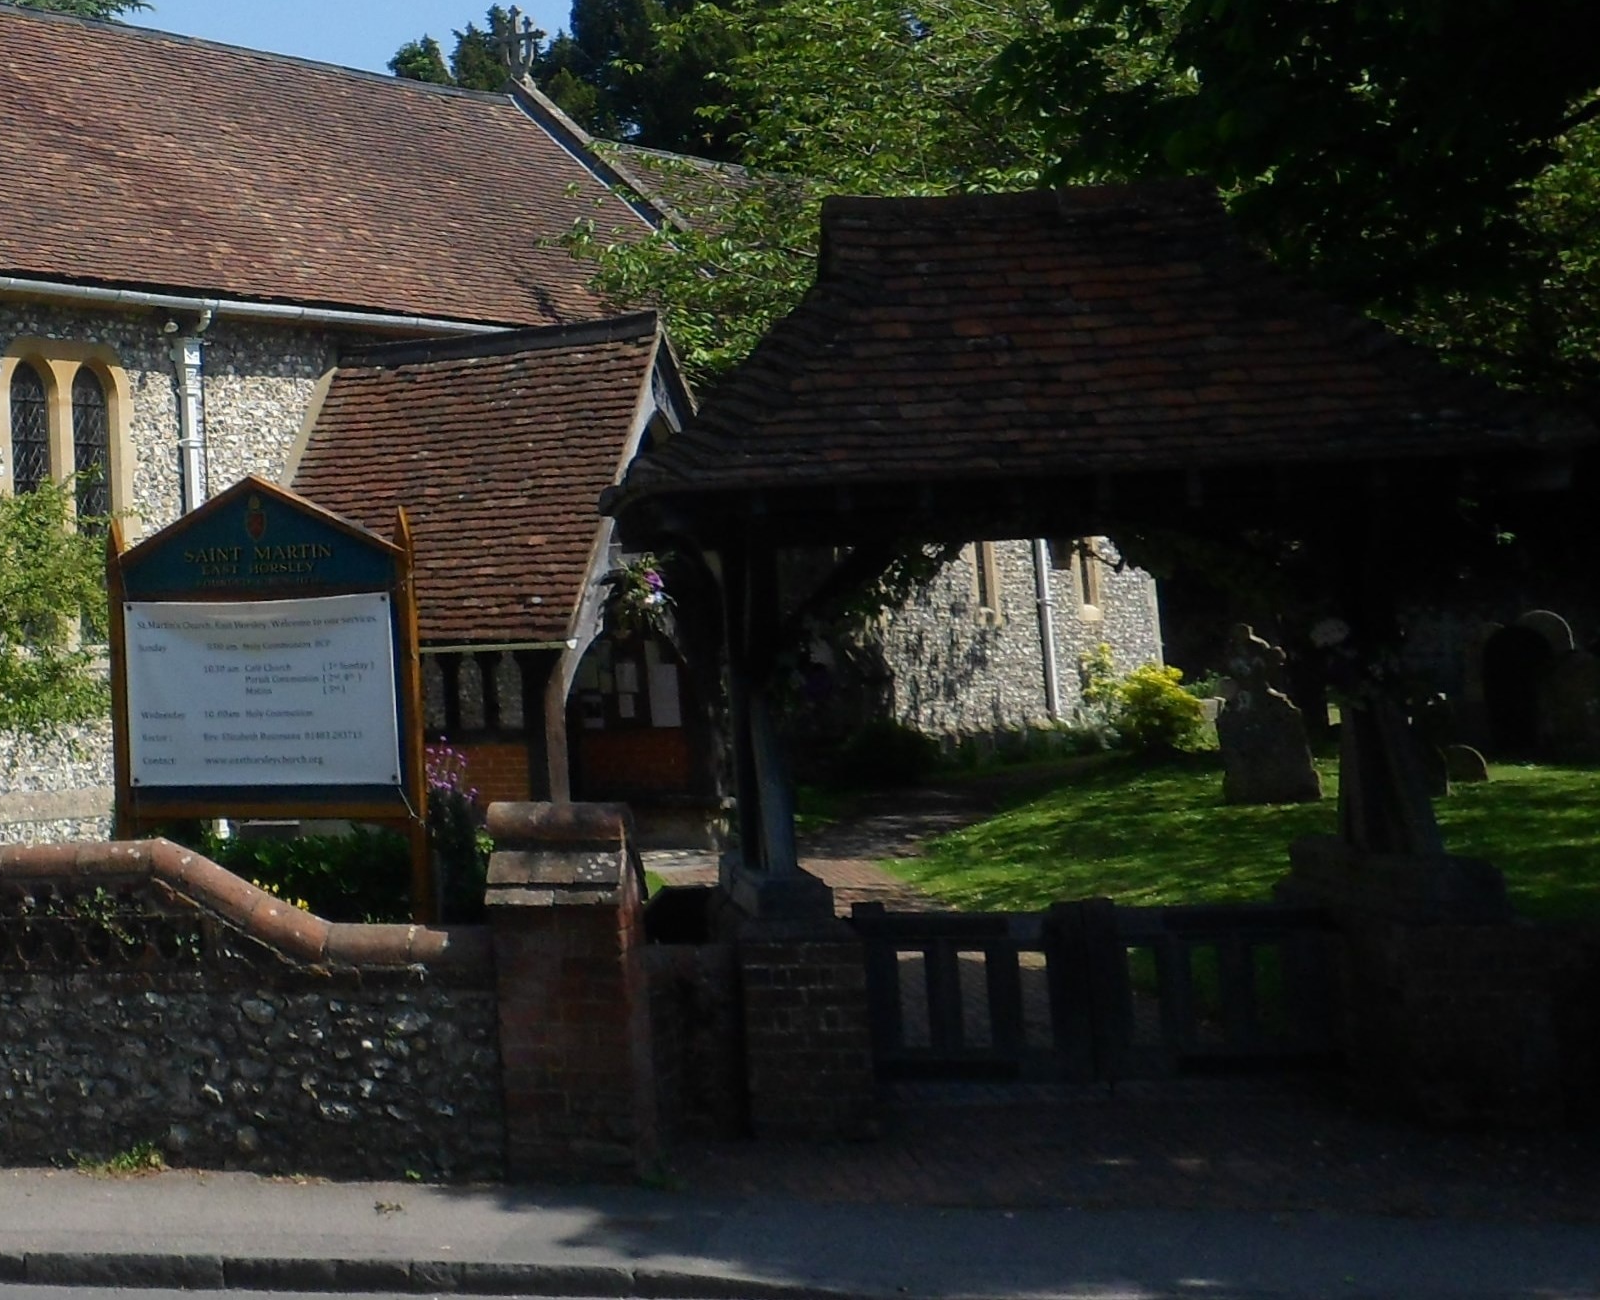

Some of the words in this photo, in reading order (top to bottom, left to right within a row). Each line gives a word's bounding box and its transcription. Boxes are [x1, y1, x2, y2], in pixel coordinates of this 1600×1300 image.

[184, 546, 242, 564] SAINT
[253, 543, 332, 561] MARTIN
[201, 564, 241, 576] EAST
[249, 562, 315, 575] HORSLEY
[271, 618, 311, 629] Welcome
[313, 618, 321, 626] to
[138, 643, 167, 653] Sunday
[242, 642, 261, 652] Holy
[262, 641, 311, 650] Communion
[264, 663, 292, 673] Church
[340, 660, 369, 671] Sunday
[245, 675, 270, 684] Parish
[272, 675, 319, 683] Communion
[141, 710, 186, 720] Wednesday
[246, 708, 265, 719] Holy
[265, 708, 313, 717] Communion
